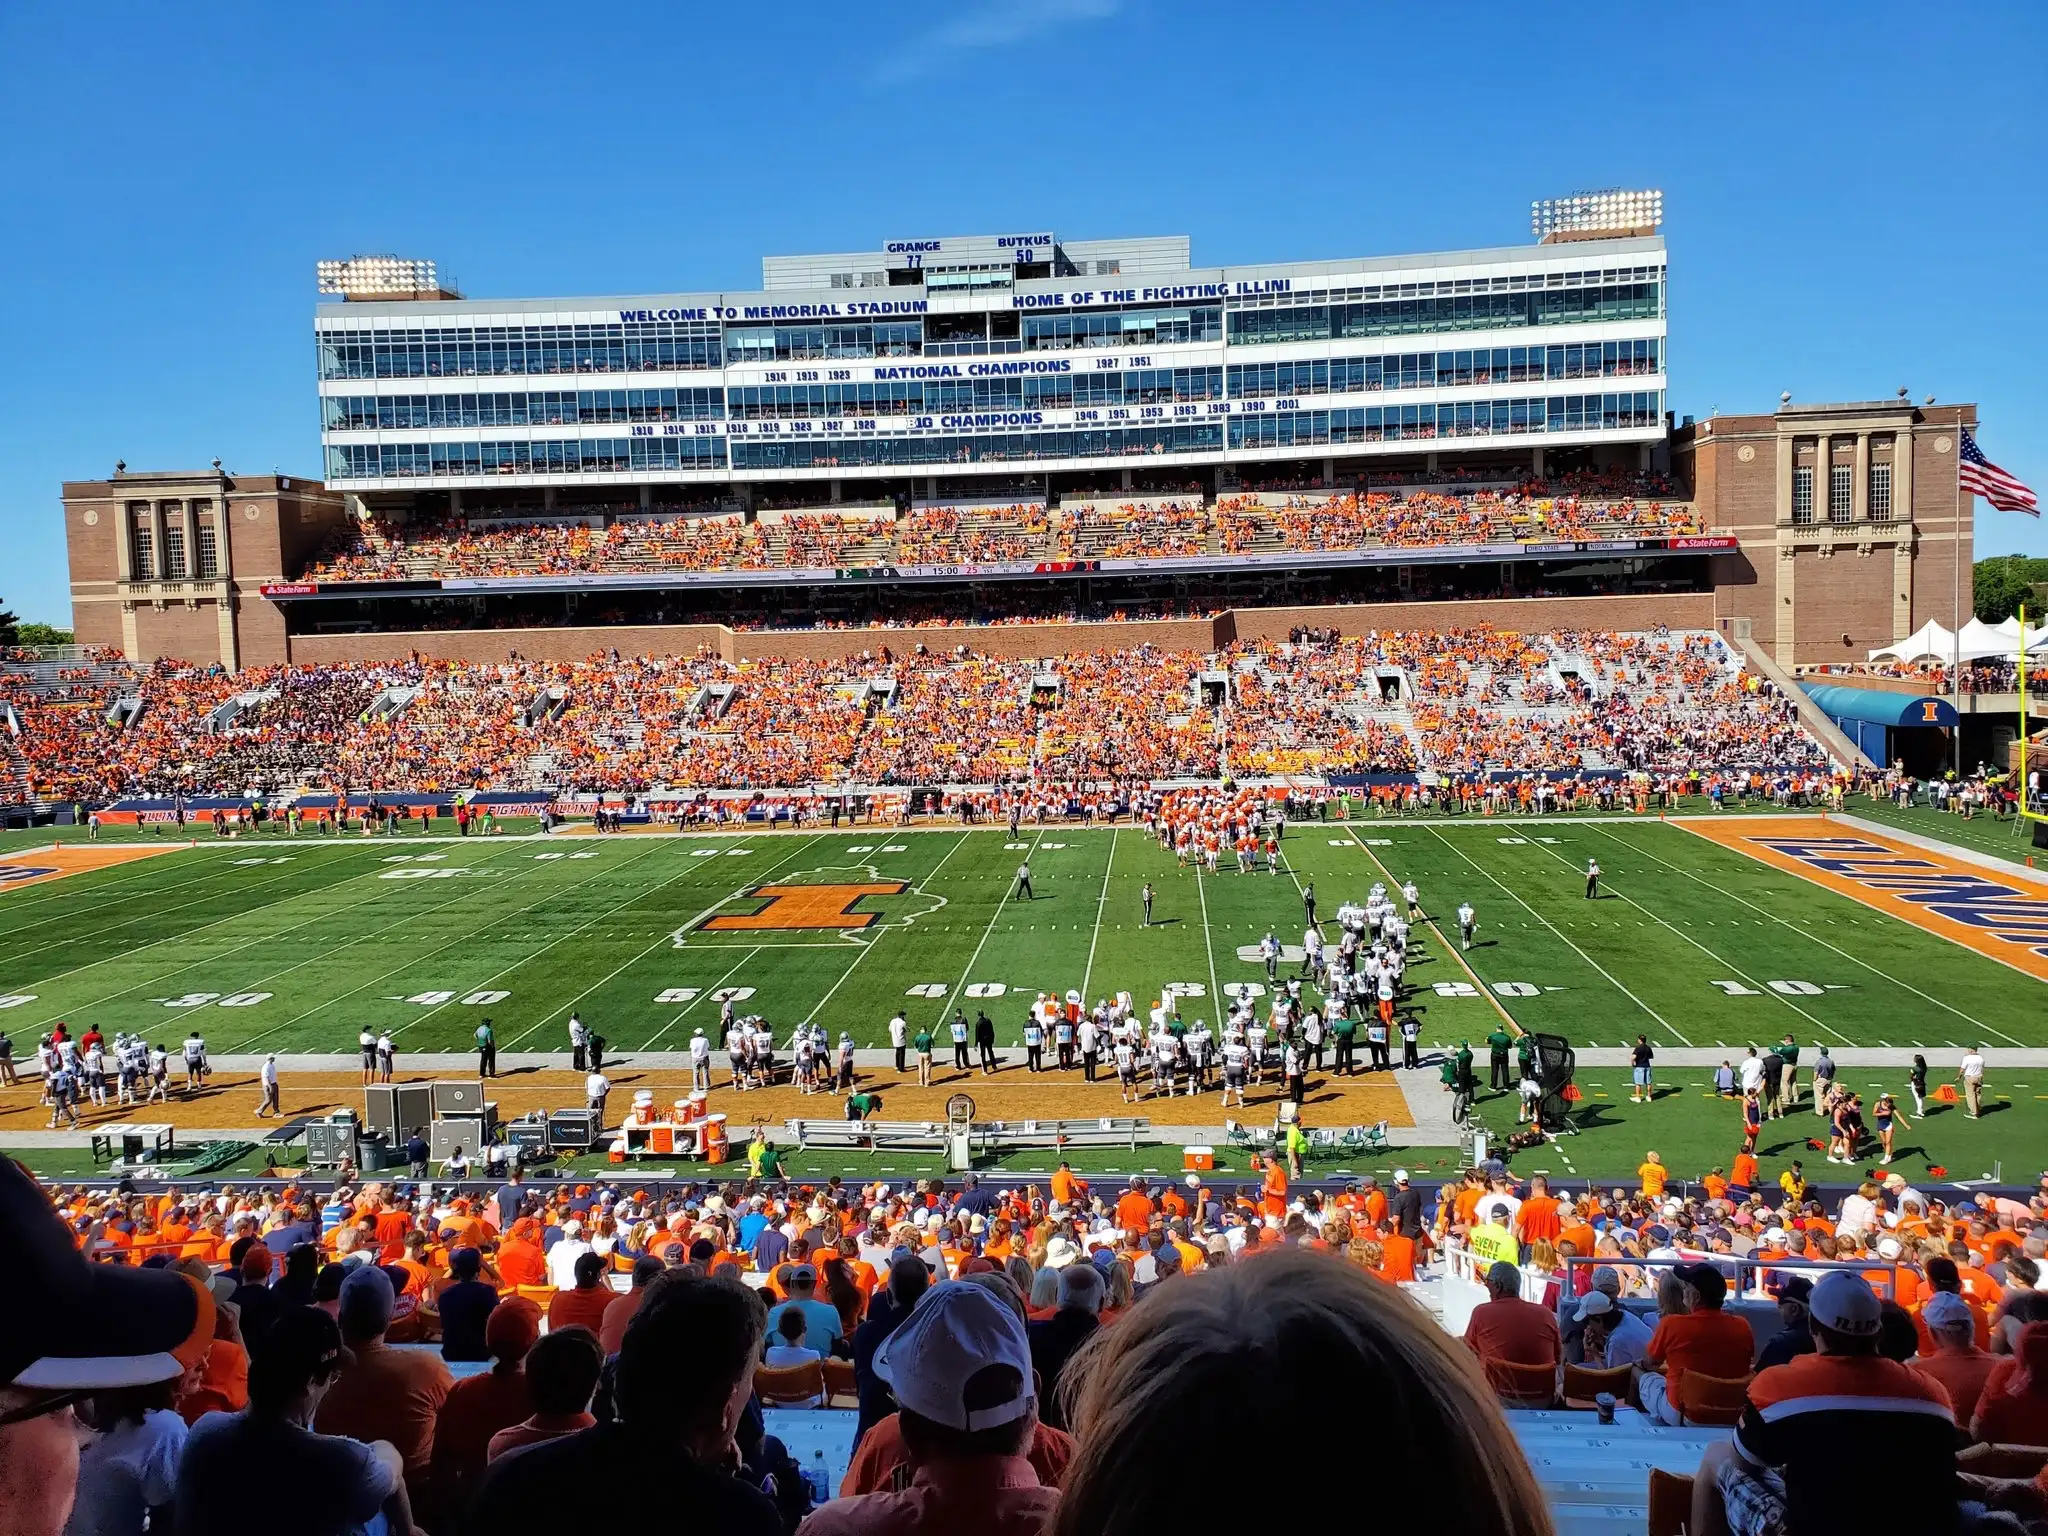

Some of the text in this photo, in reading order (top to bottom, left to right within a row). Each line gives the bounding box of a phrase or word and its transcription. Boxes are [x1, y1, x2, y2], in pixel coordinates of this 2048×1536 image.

[887, 241, 941, 253] GRANGE
[998, 234, 1051, 248] BUTKUS
[906, 254, 922, 269] 77
[1016, 248, 1034, 265] 50
[1012, 279, 1291, 309] HOME OF THE FIGHTING ILLINI
[619, 300, 928, 323] WELCOME TO MEMORIAL STADIUM
[765, 356, 1152, 383] 1914 1919 1923 NATIONAL CHAMPIONS 1927 1951
[631, 426, 654, 436] 1910
[663, 425, 685, 435] 1914
[694, 424, 717, 434] 1915
[758, 423, 780, 433] 1919
[789, 422, 812, 432] 1923
[821, 421, 843, 431] 1927
[853, 420, 876, 430] 1928
[941, 412, 1043, 427] CHAMPIONS
[1075, 411, 1099, 421] 1946
[1108, 409, 1130, 419] 1951
[1140, 407, 1163, 418] 1953
[1207, 403, 1231, 414] 1983
[1241, 401, 1265, 412] 1990
[1275, 399, 1300, 409] 2001
[932, 566, 958, 575] 15:00
[904, 983, 1008, 999] 40
[1431, 982, 1543, 999] 20
[1708, 978, 1827, 997] 10
[162, 992, 275, 1008] 30
[401, 990, 513, 1006] 40
[1474, 1236, 1501, 1253] EVENT
